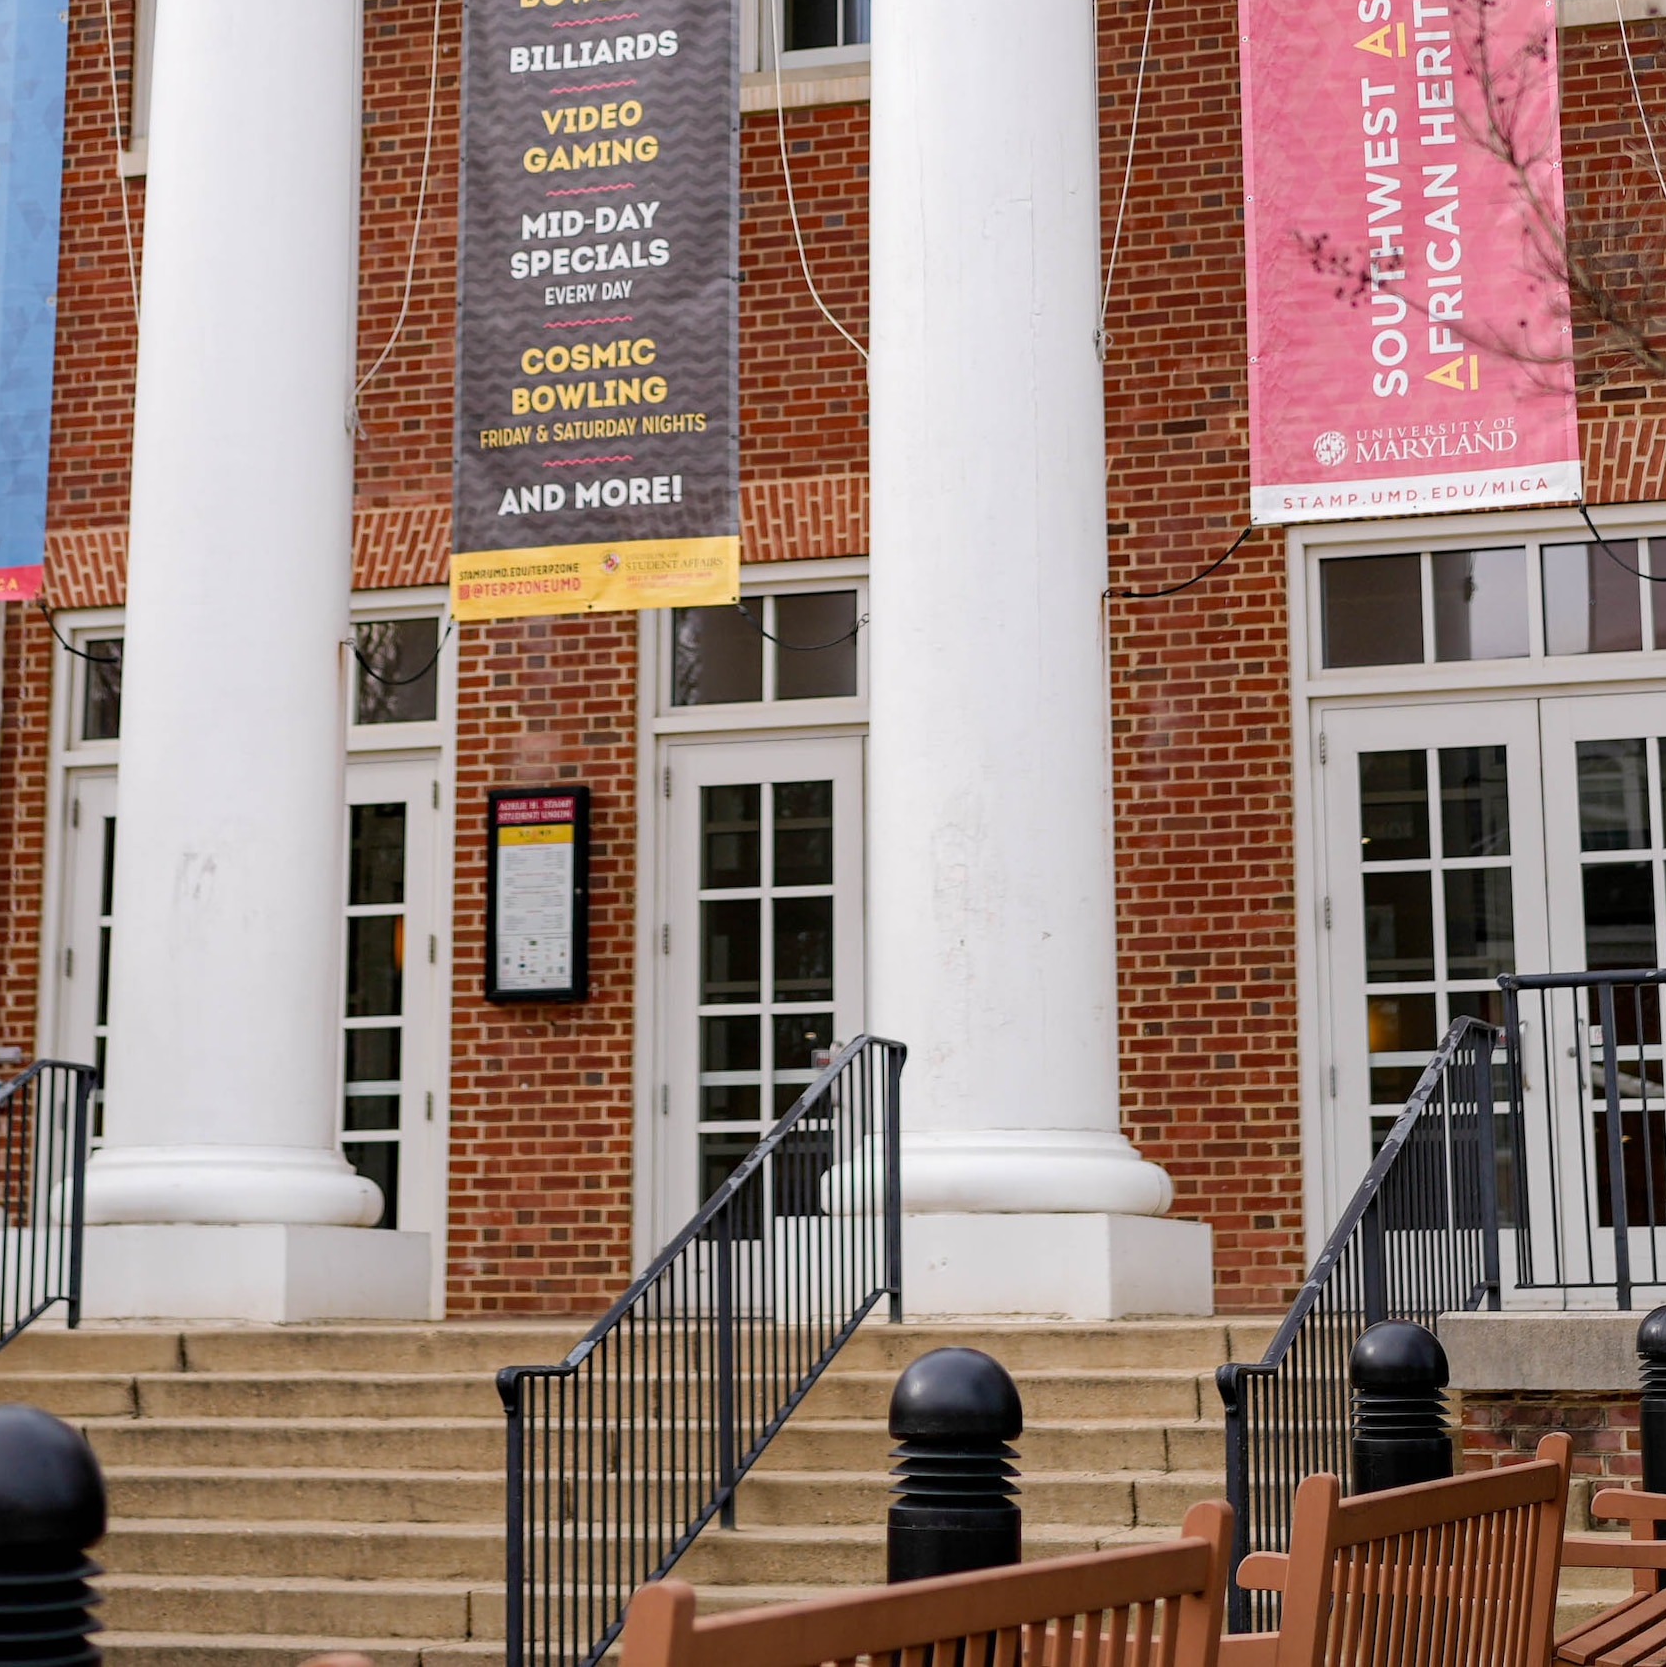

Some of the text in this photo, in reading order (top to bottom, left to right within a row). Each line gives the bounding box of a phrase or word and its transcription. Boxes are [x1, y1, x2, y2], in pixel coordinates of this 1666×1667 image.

[509, 30, 679, 73] BILLIARDS
[541, 100, 643, 135] VIDEO
[522, 135, 659, 174] GAMING
[520, 201, 661, 240] MID-DAY
[1361, 77, 1409, 398] SOUTHWEST
[510, 238, 670, 280] SPECIALS
[1422, 163, 1465, 391] AFRICAN
[544, 279, 633, 306] EVERY DAY
[520, 338, 657, 375] COSMIC
[511, 376, 669, 416] BOWLING
[480, 412, 707, 449] FRIDAY & SATURDAY NIGHTS
[1355, 428, 1518, 464] MARYLAND
[1356, 416, 1515, 442] UNIVERSITY OF
[498, 474, 683, 516] AND MORE!
[1283, 477, 1549, 510] STAMP.UMD.EDU/MICA
[626, 556, 724, 572] STUDENT AFFAIRS
